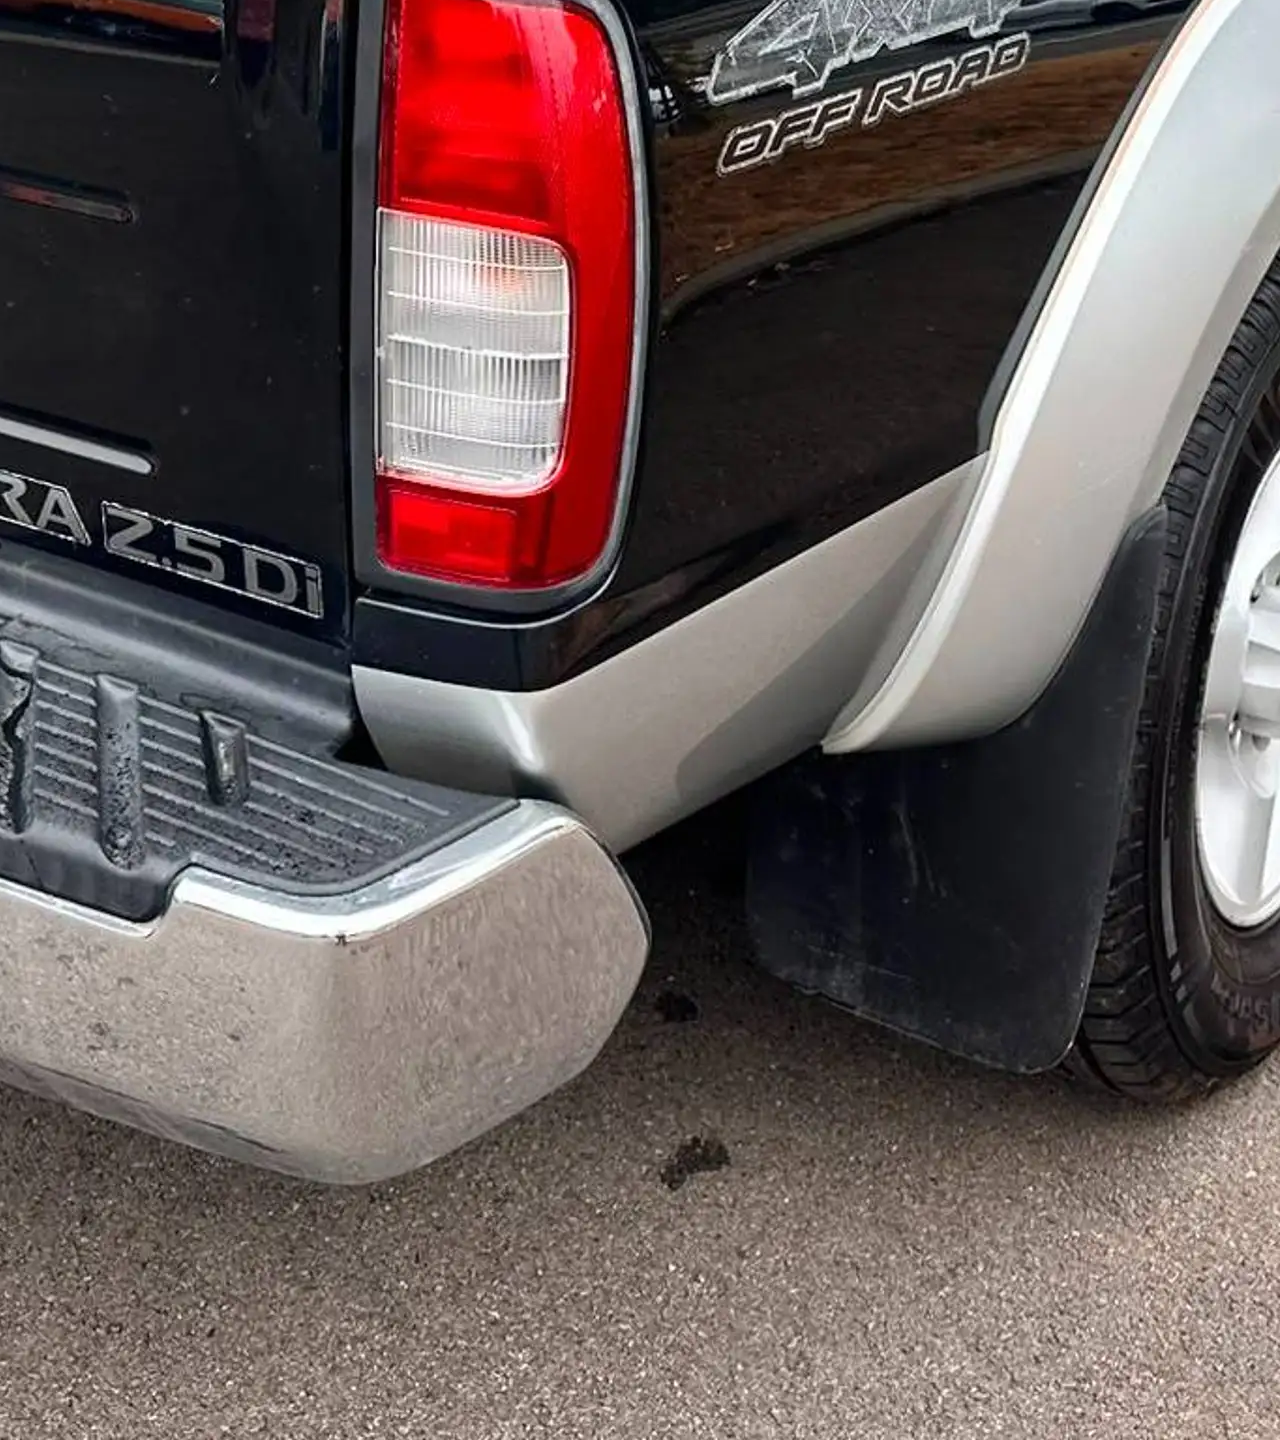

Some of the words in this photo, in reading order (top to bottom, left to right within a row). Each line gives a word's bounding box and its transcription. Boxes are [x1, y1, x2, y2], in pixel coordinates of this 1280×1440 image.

[717, 86, 864, 177] OFF
[861, 31, 1031, 126] ROAD
[104, 504, 228, 583] 2.5
